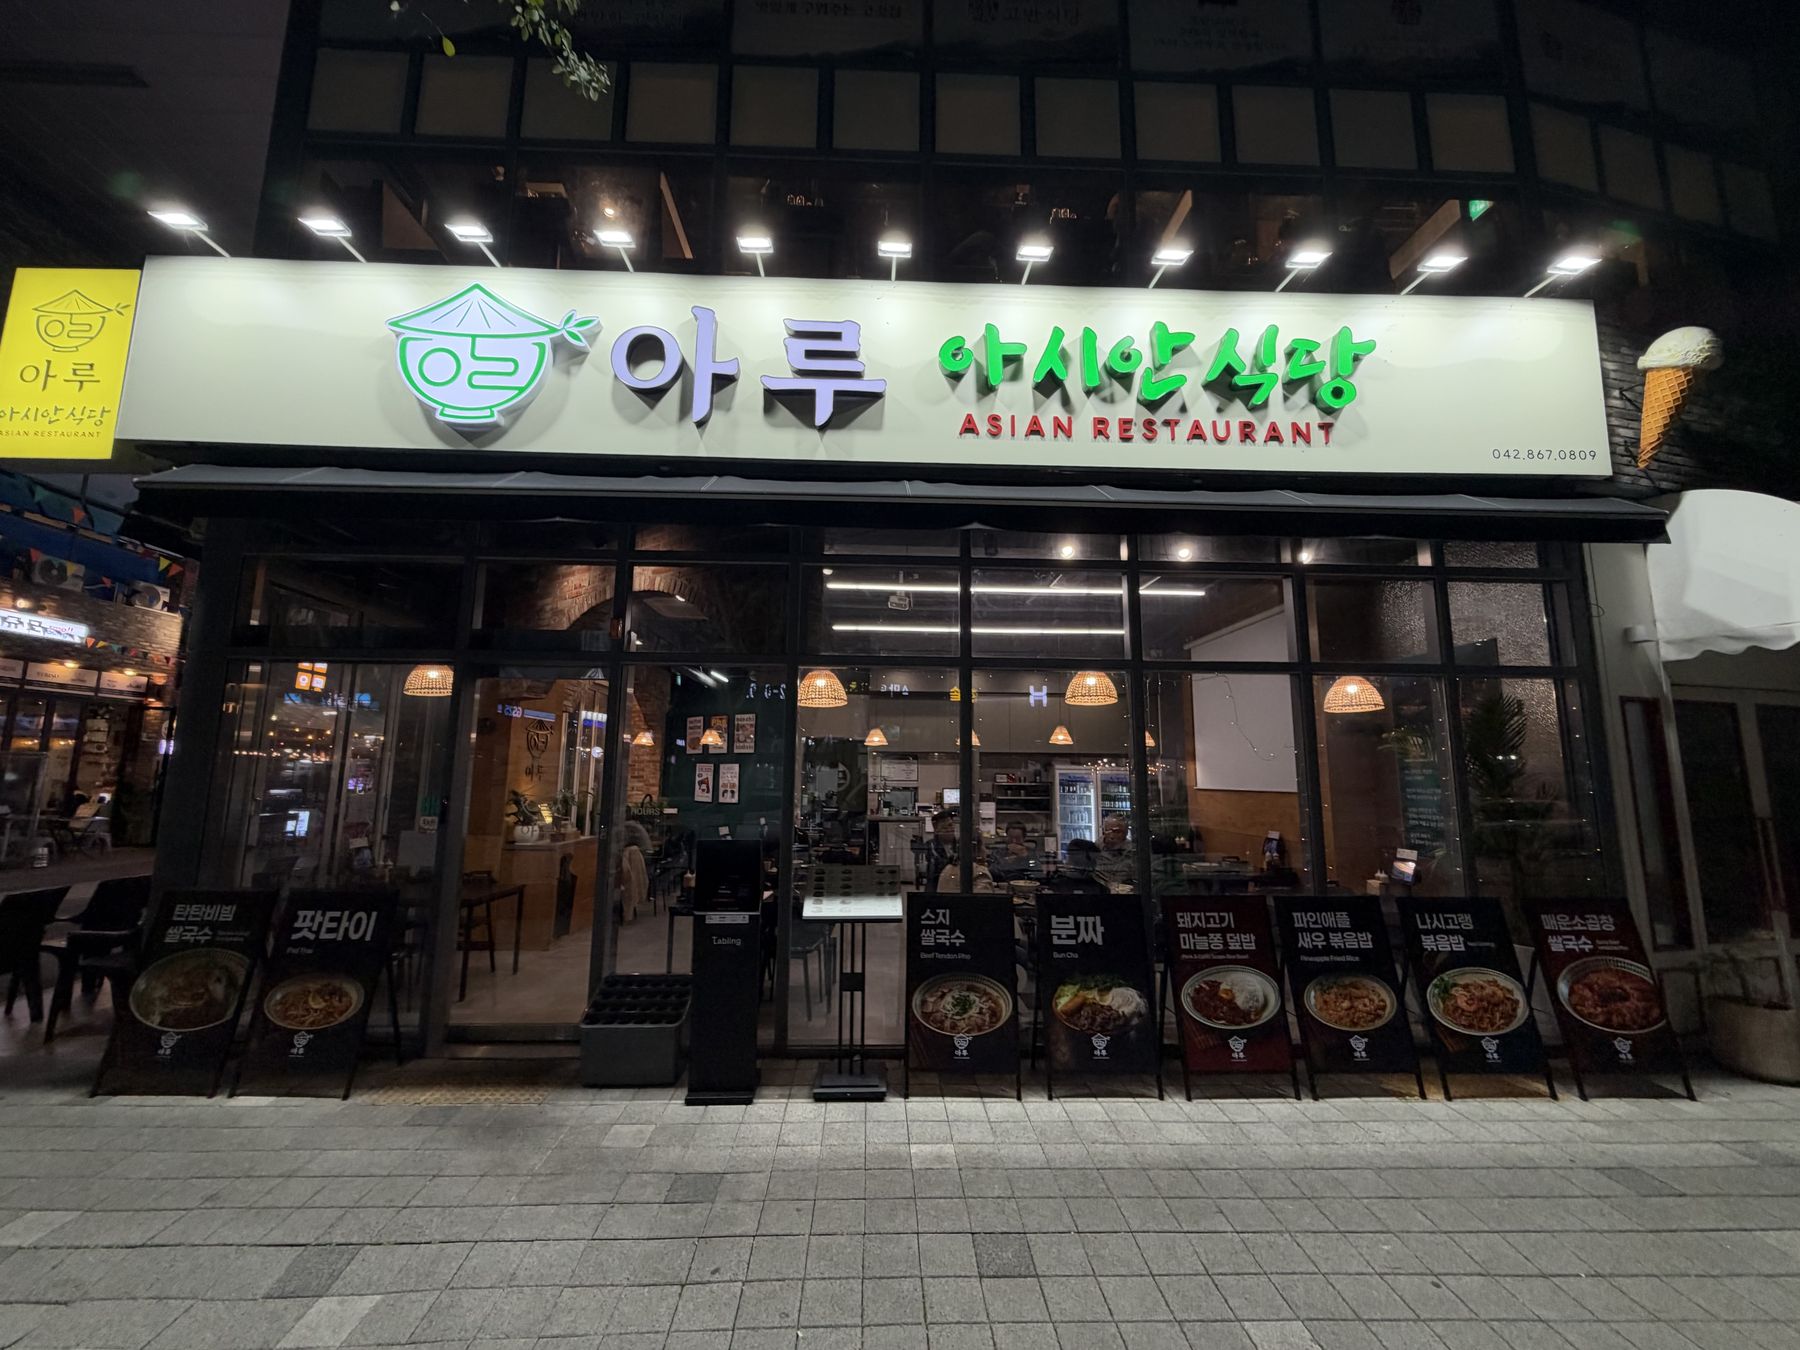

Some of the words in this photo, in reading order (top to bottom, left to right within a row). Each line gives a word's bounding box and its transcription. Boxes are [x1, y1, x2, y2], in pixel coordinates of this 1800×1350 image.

[20, 359, 100, 392] 아루
[610, 305, 887, 429] 아루
[959, 413, 1073, 438] ASIAN
[1092, 416, 1335, 445] RESTAURANT
[1492, 448, 1597, 461] 042.867.0809
[290, 910, 378, 942] 팟타이
[920, 908, 950, 926] 스지
[1176, 911, 1235, 929] 돼지고기
[1291, 911, 1351, 929] 파인애플
[1540, 913, 1616, 932] 매운소곱창
[164, 926, 213, 944] 쌀국수
[920, 928, 966, 947] 쌀국수
[1050, 915, 1104, 946] 분짜
[711, 935, 742, 946] Tabling
[1225, 932, 1256, 950] 덮밥
[1297, 931, 1327, 949] 새우
[1328, 931, 1373, 949] 볶음밥
[1420, 934, 1467, 952] 볶음밥
[1547, 934, 1595, 953] 쌀국수
